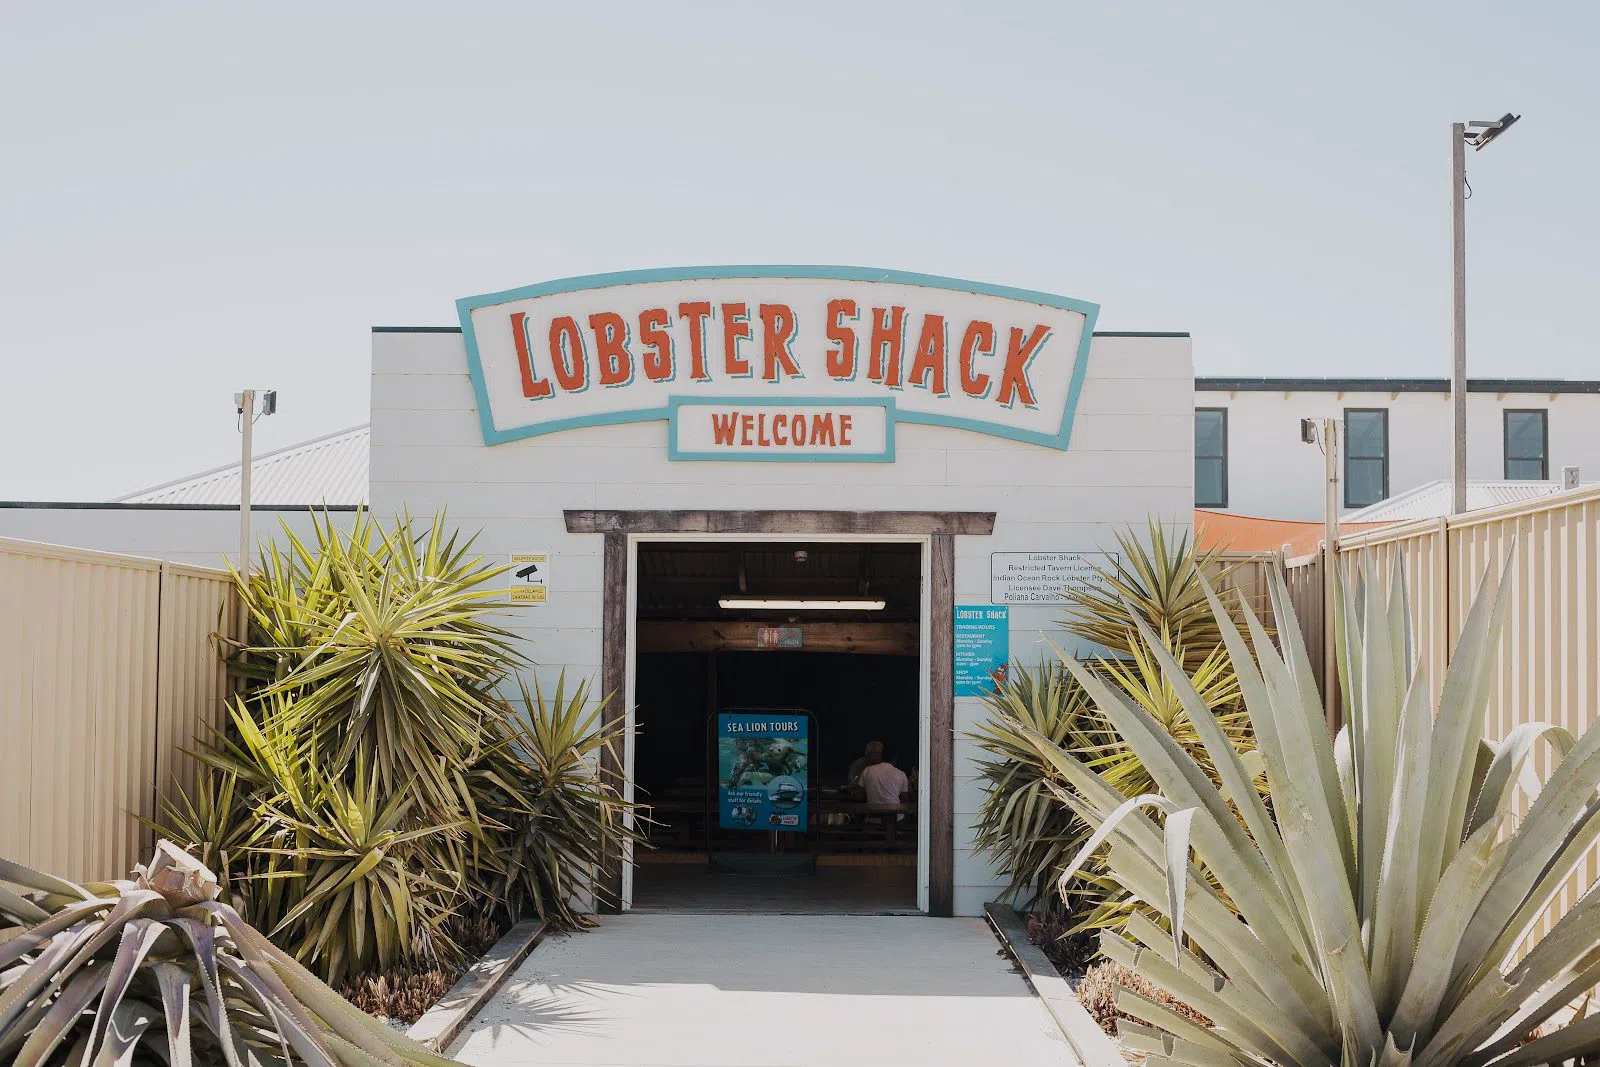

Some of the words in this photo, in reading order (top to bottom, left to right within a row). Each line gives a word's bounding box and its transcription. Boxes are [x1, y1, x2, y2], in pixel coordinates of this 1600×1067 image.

[510, 300, 806, 400] LOBSTER
[825, 298, 1053, 409] SHACK
[711, 412, 854, 448] WELCOME
[1008, 564, 1046, 572] Restricted
[1047, 564, 1072, 572] Tavern
[1091, 574, 1103, 583] Pty
[1004, 592, 1029, 601] Poliana
[956, 609, 984, 619] LOBSTER
[986, 610, 1007, 619] SHACK
[727, 722, 744, 732] SEA
[746, 722, 767, 732] LION
[769, 721, 799, 732] TOURS
